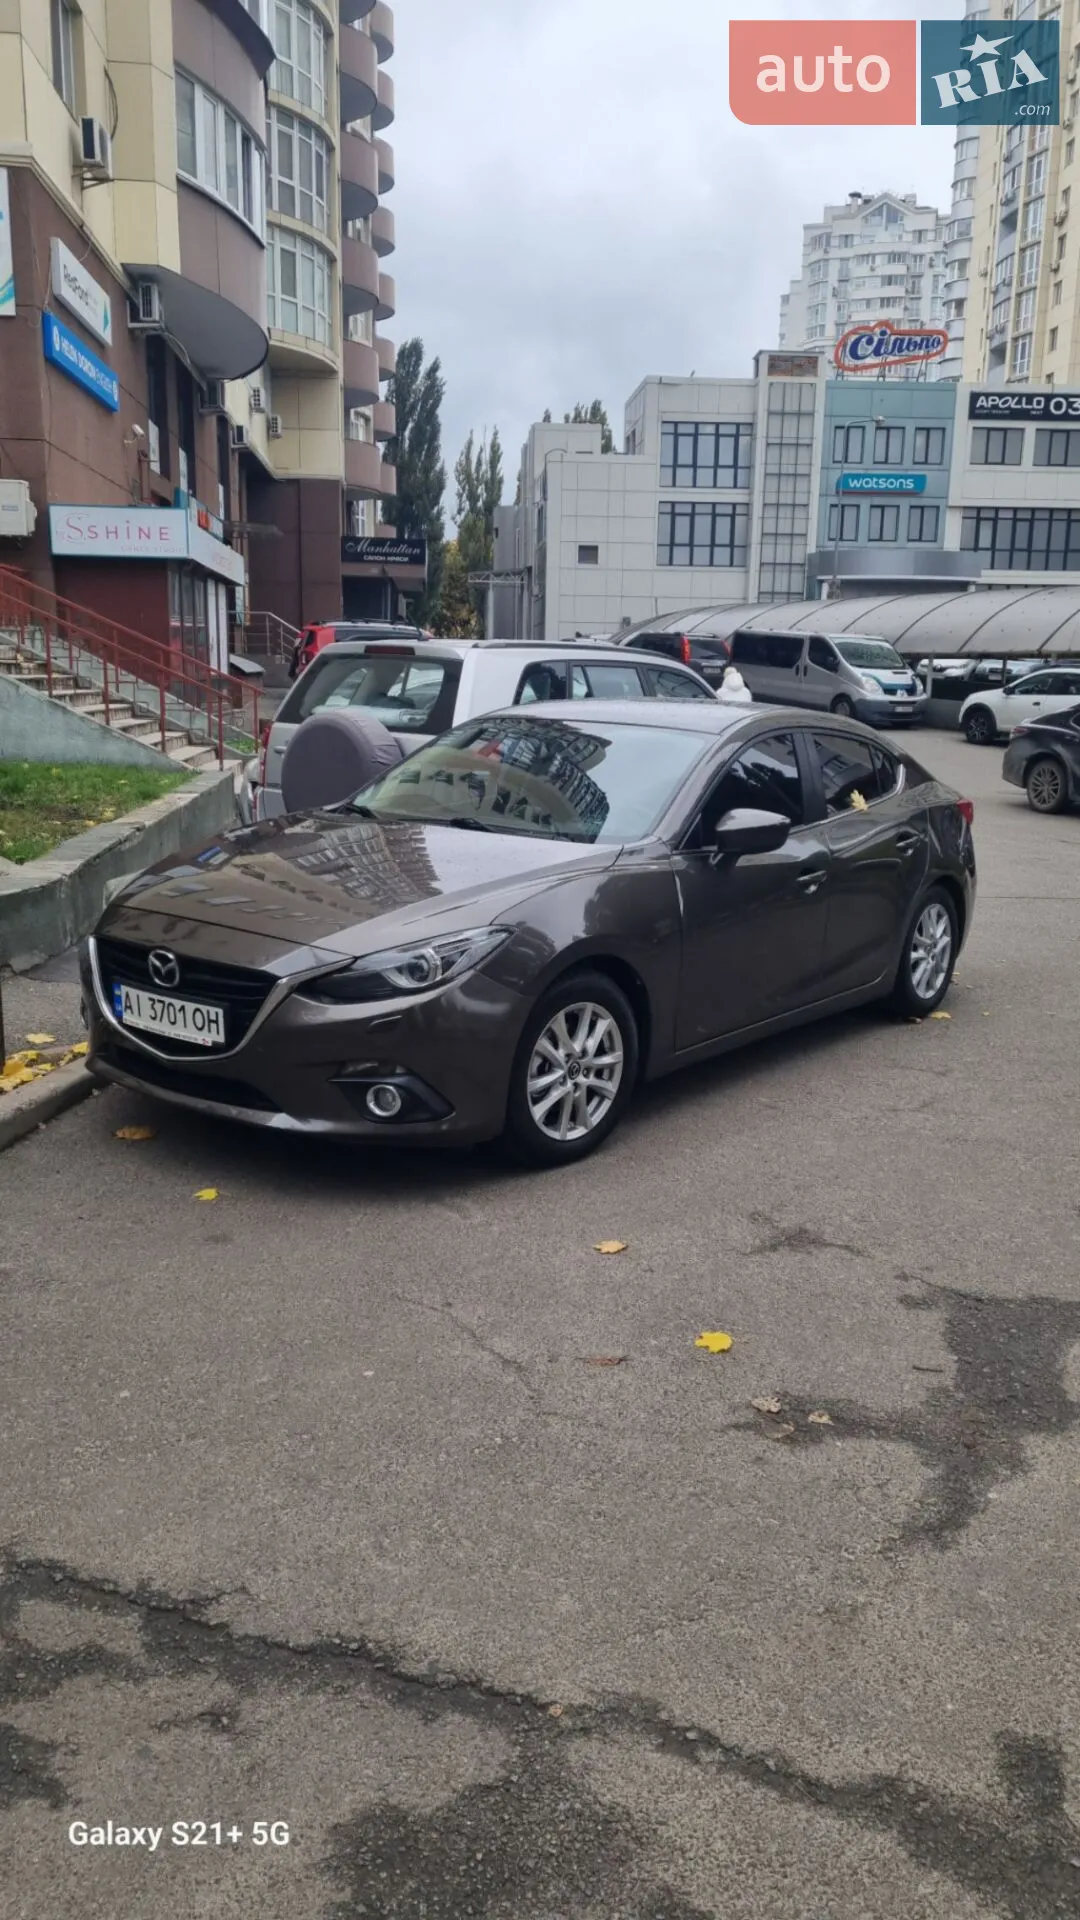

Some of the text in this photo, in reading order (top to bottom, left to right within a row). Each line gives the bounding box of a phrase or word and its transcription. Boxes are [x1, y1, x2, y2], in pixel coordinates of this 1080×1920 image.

[849, 328, 942, 360] Сільпо
[976, 396, 1045, 409] APOLLO
[848, 477, 915, 489] watsons
[345, 538, 421, 555] Manhattan
[124, 991, 141, 1018] AI
[148, 997, 187, 1029] 3701
[192, 1007, 220, 1036] OH
